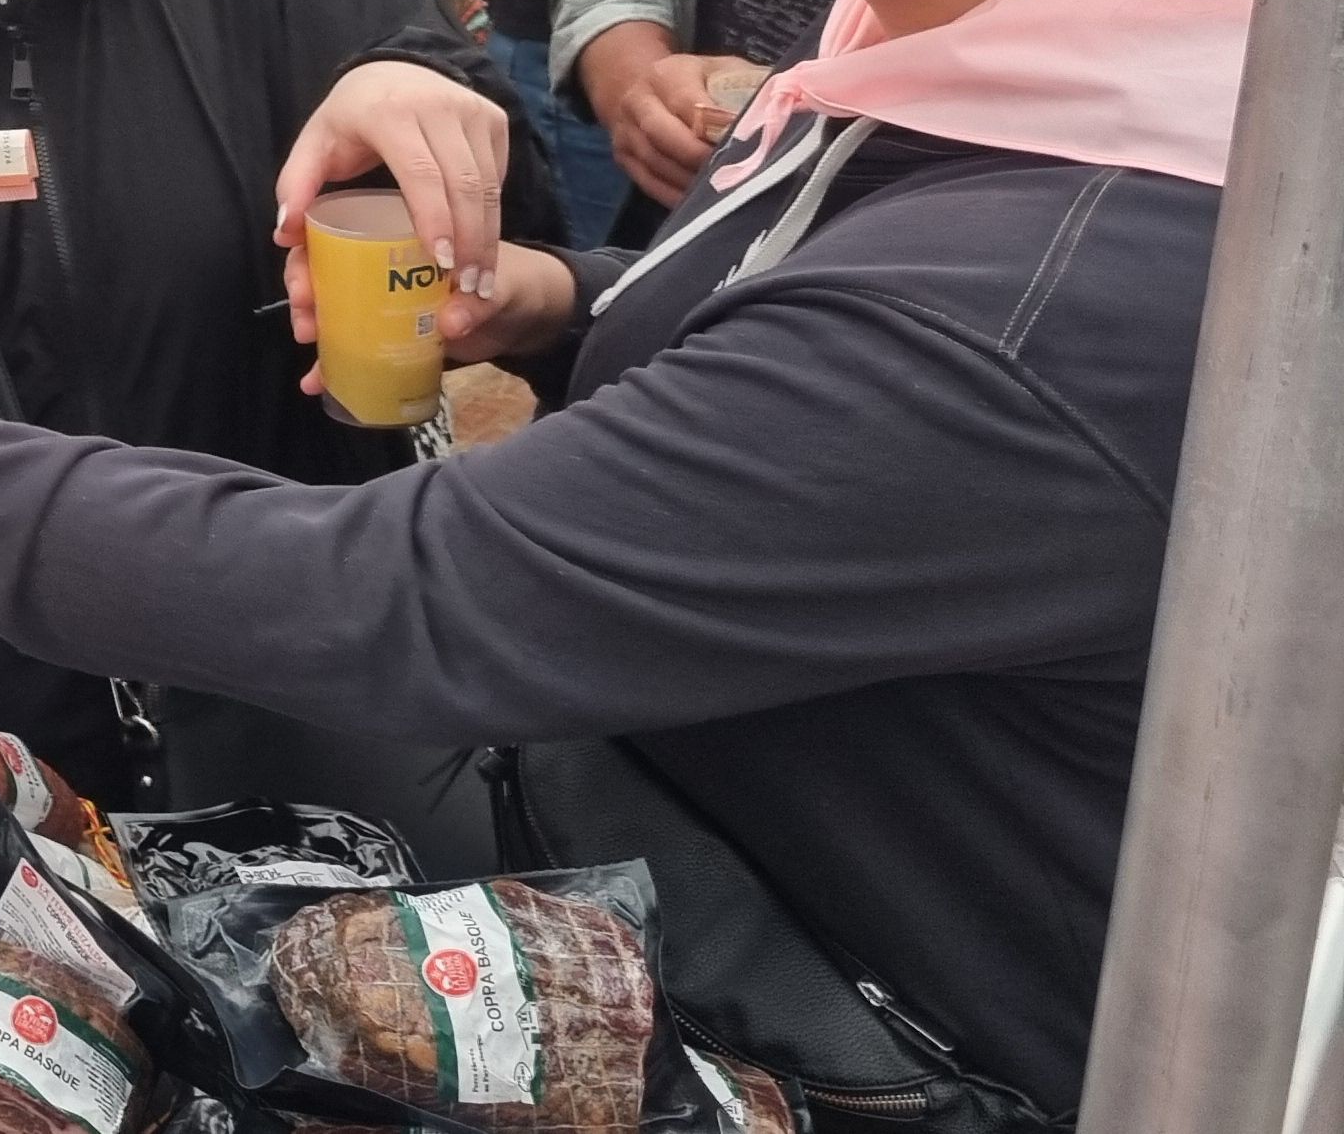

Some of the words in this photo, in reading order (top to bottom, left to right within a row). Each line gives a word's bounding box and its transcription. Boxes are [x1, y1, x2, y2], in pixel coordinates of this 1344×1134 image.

[458, 910, 492, 968] BASQUE
[483, 972, 505, 1033] COPPA
[23, 1046, 81, 1092] BASQUE
